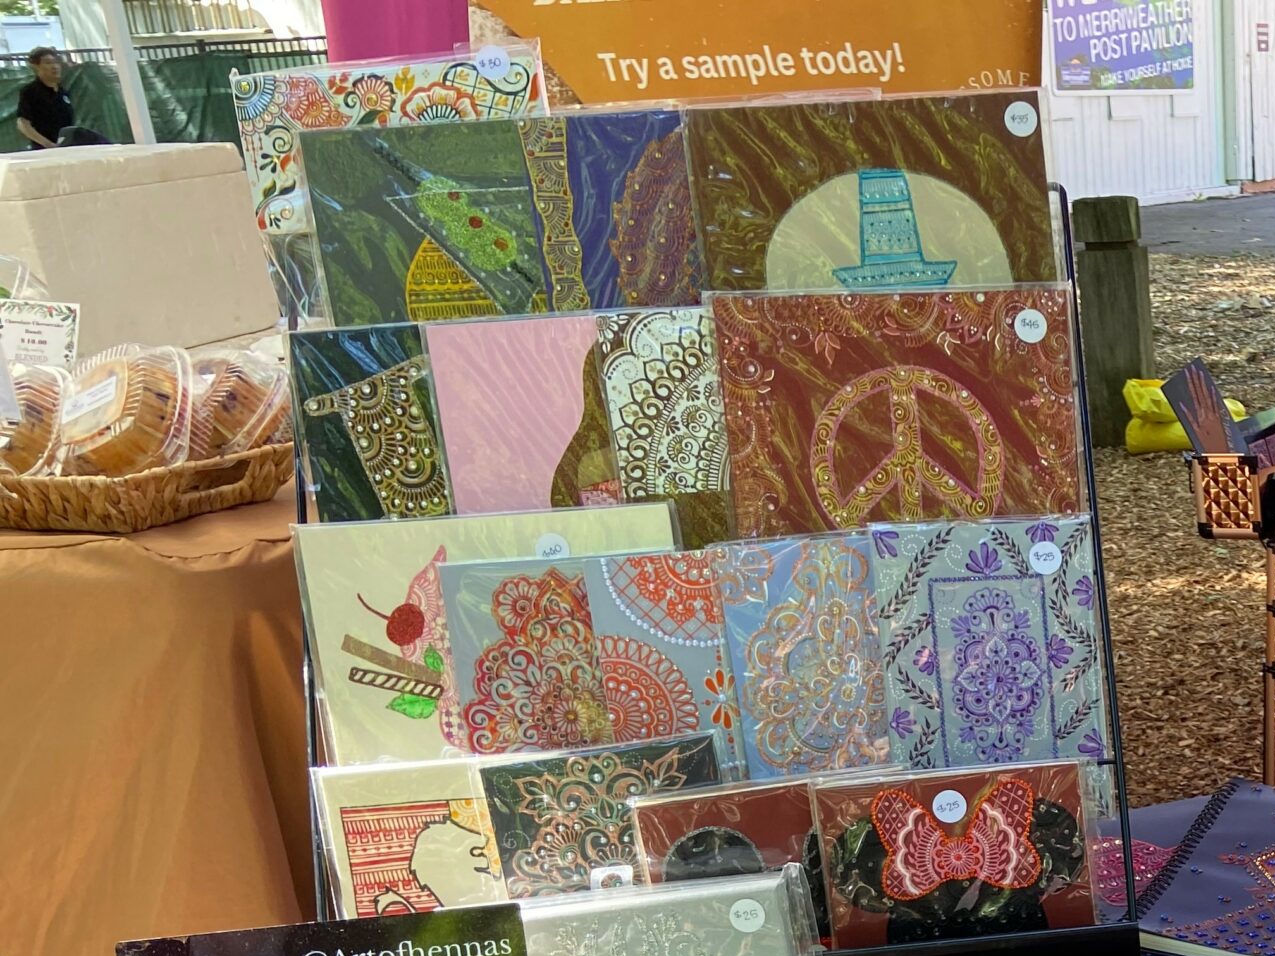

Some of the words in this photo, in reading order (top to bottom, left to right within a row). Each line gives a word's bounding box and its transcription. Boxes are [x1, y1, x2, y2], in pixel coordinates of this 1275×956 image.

[1054, 16, 1076, 42] TO
[1078, 0, 1192, 38] MERRIWEATHER
[1089, 32, 1128, 62] POST
[1131, 22, 1193, 55] PAVILION
[596, 52, 649, 90] Try
[656, 56, 678, 80] a
[681, 45, 796, 85] sample
[800, 42, 906, 82] today!
[1100, 71, 1124, 87] MAKE
[1123, 63, 1162, 81] YOURSELF
[1161, 60, 1173, 73] AT
[1172, 55, 1193, 71] HOME
[1033, 551, 1055, 561] $25
[937, 800, 960, 813] $25
[734, 909, 759, 921] $25
